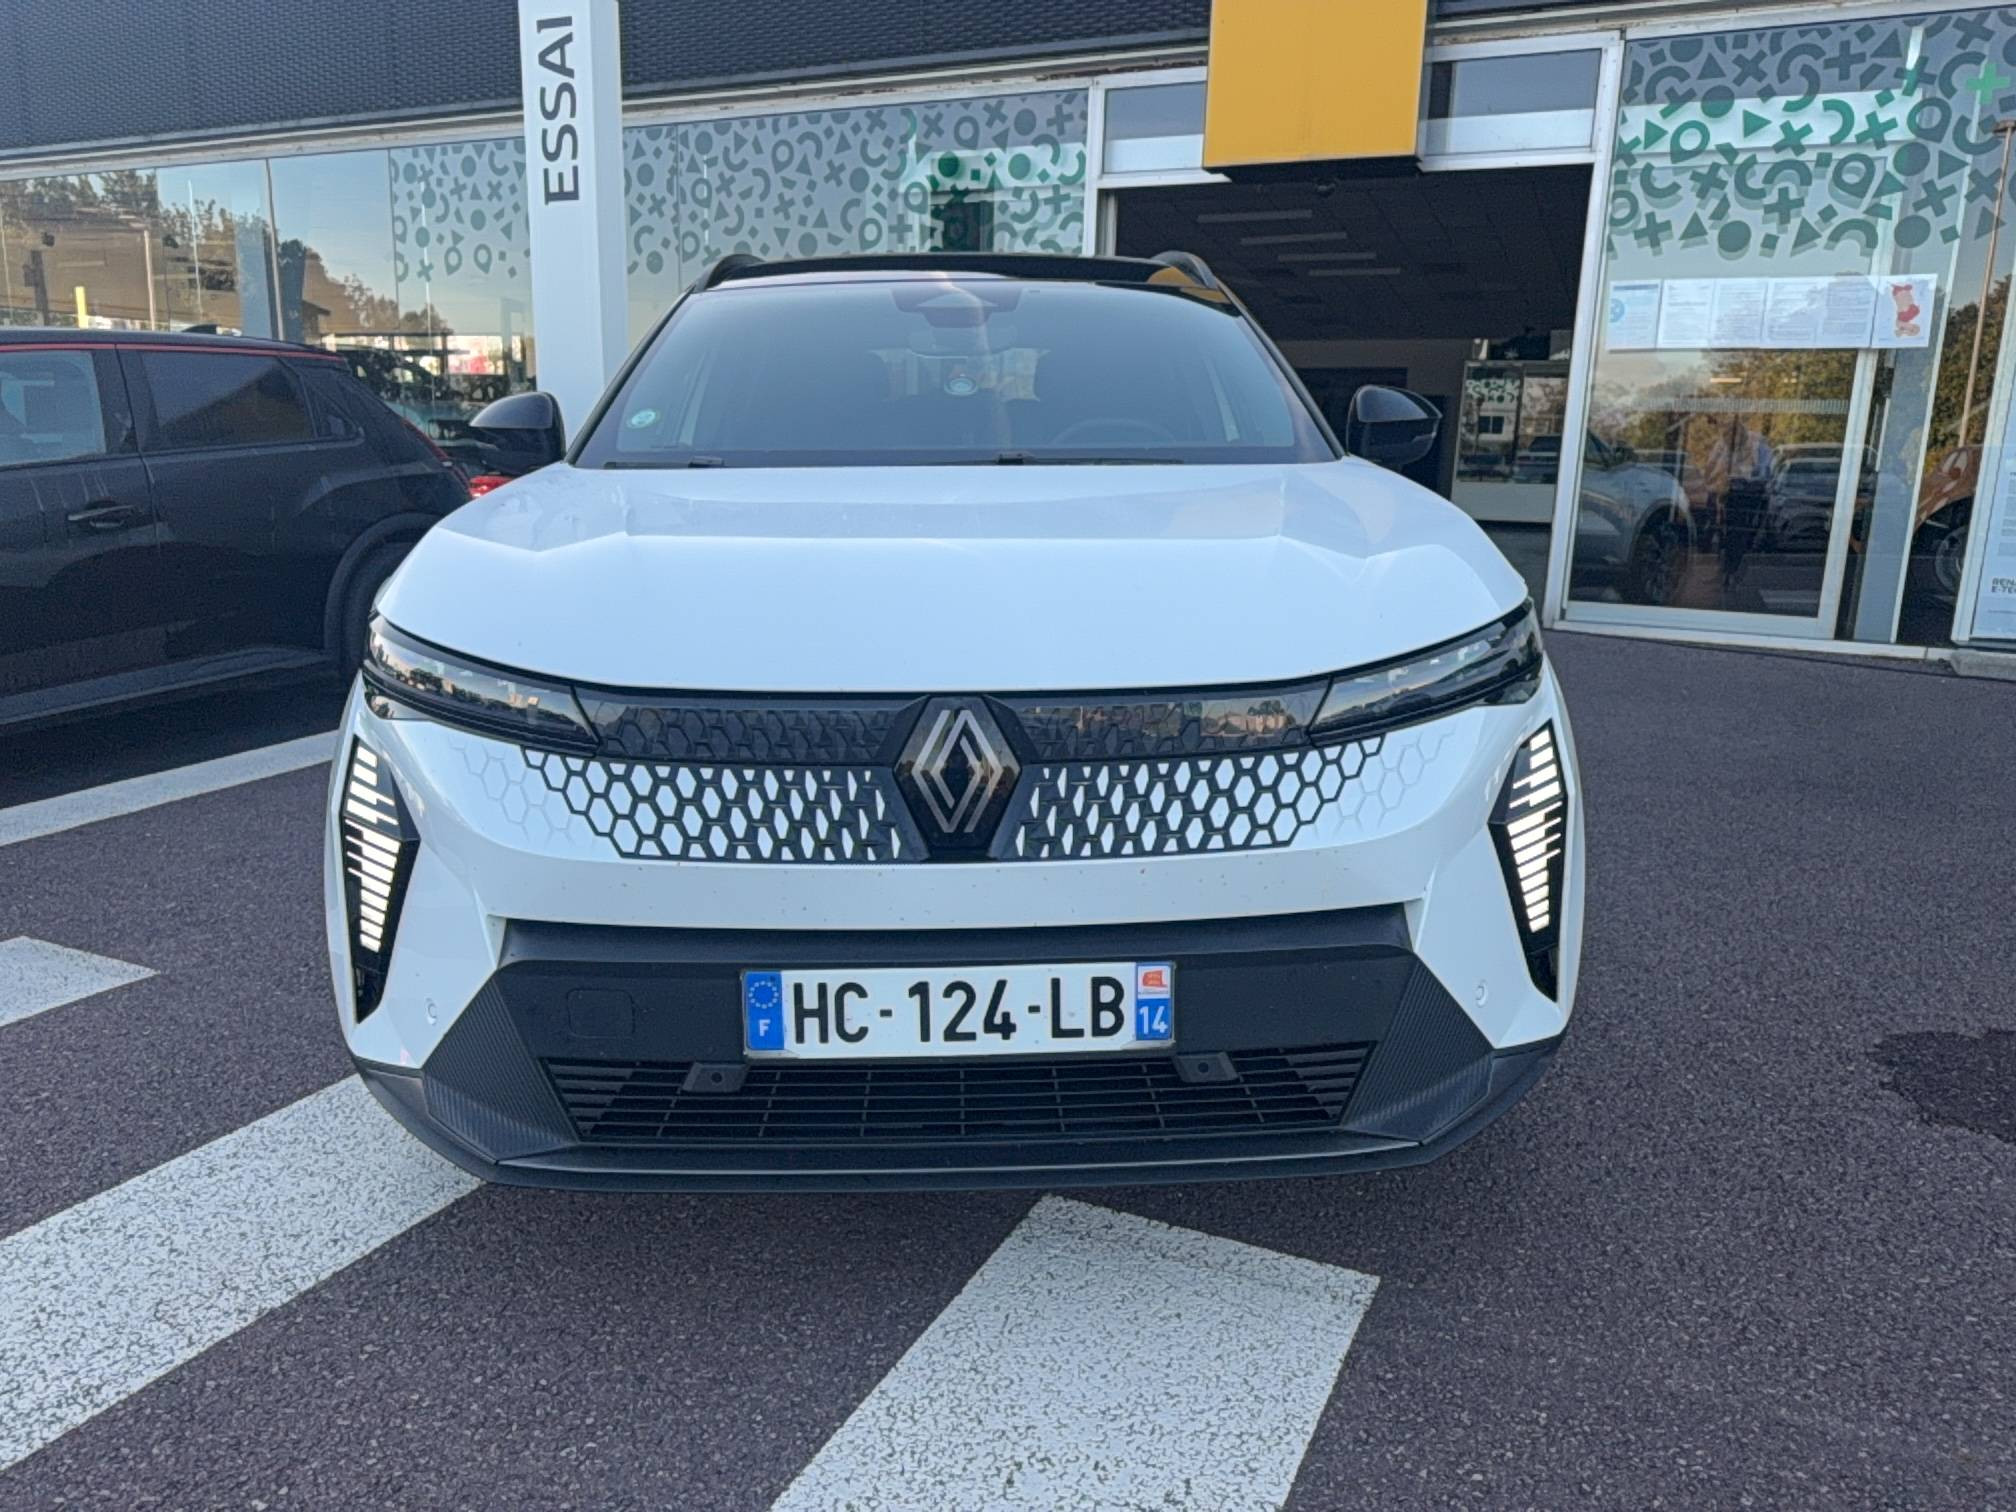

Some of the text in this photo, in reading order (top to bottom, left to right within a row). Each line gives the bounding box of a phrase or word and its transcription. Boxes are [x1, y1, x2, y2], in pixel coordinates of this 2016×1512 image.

[536, 16, 580, 206] ESSAI
[759, 1019, 771, 1037] F
[793, 976, 1125, 1044] HC-124-LB
[1139, 1005, 1169, 1034] 14
